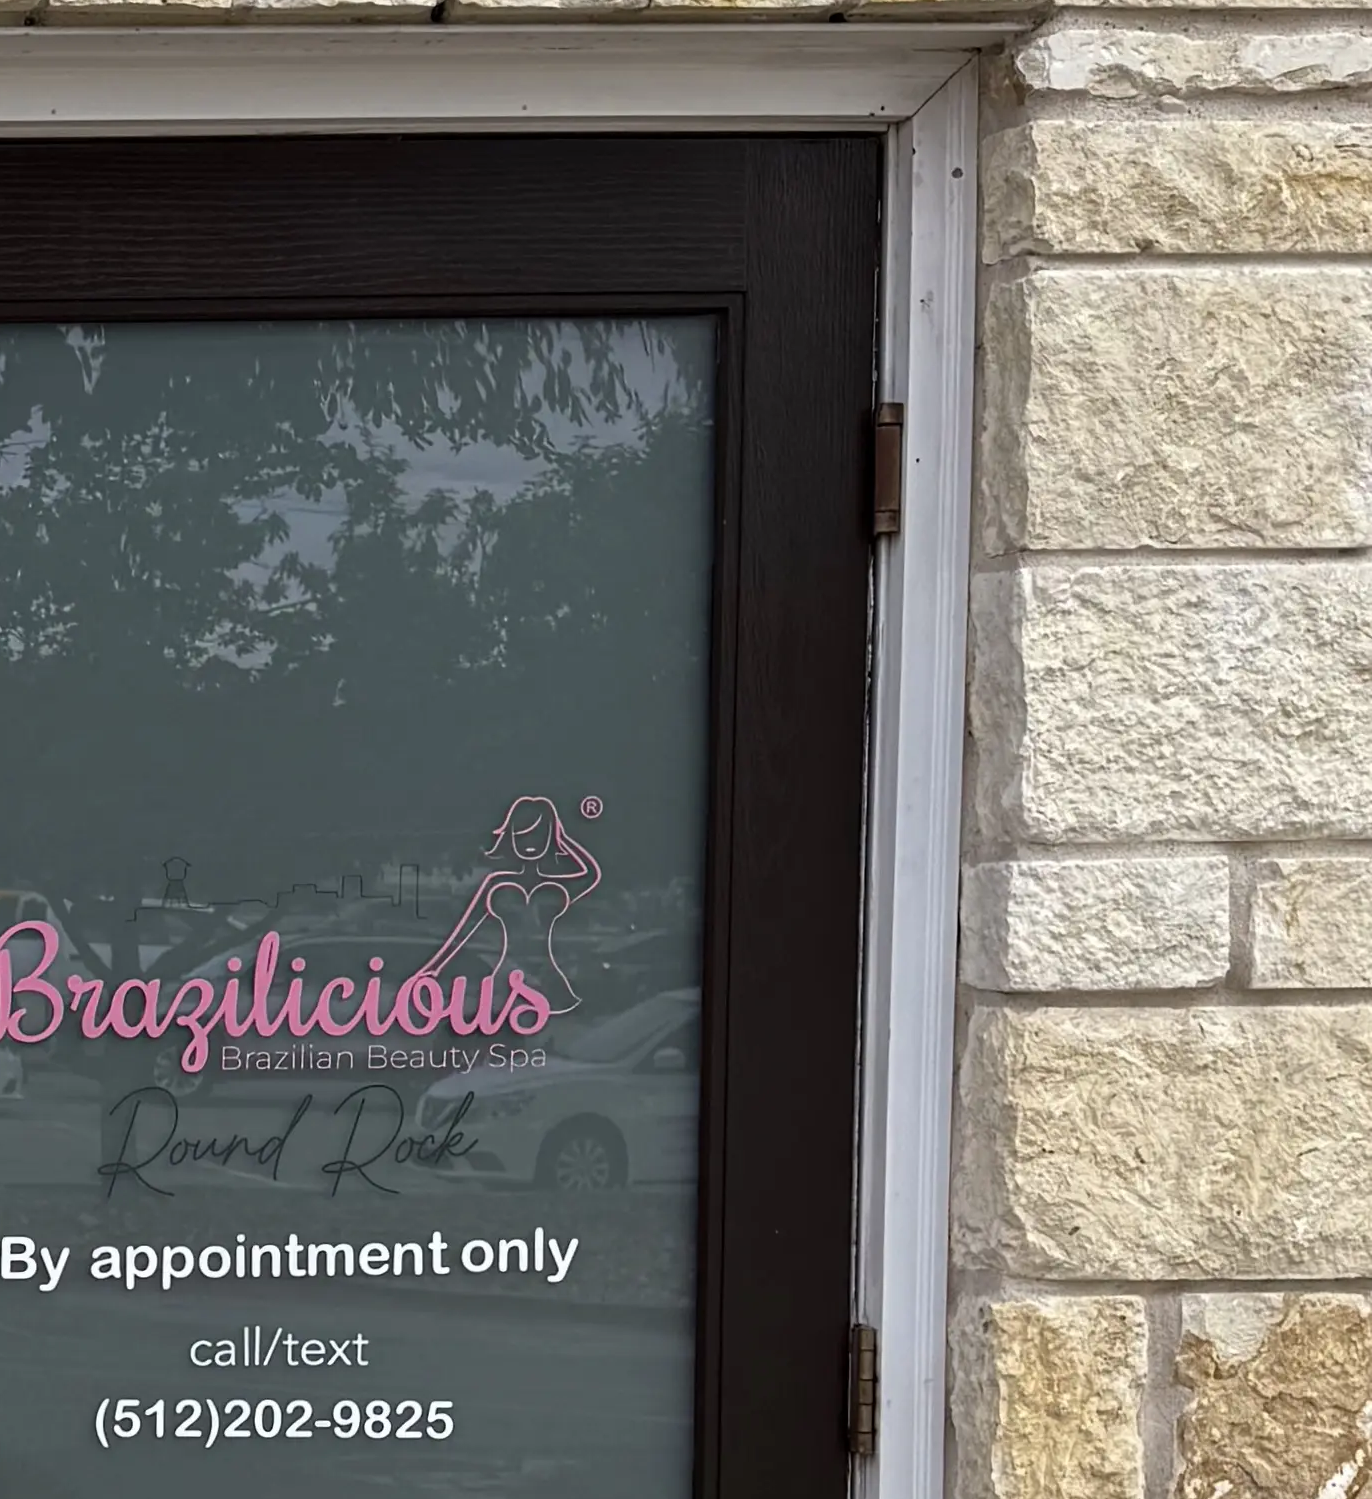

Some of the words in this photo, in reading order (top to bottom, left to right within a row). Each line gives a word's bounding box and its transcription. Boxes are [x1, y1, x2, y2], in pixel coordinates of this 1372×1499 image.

[220, 1044, 354, 1072] Brazilian
[366, 1043, 480, 1075] Beauty
[489, 1042, 548, 1073] Spa
[97, 1086, 313, 1199] Round
[321, 1084, 480, 1199] Rock
[0, 1235, 70, 1292] By
[89, 1230, 451, 1290] appointment
[459, 1227, 579, 1283] only
[189, 1325, 370, 1368] call/text
[94, 1398, 455, 1448] (512)202-9825
